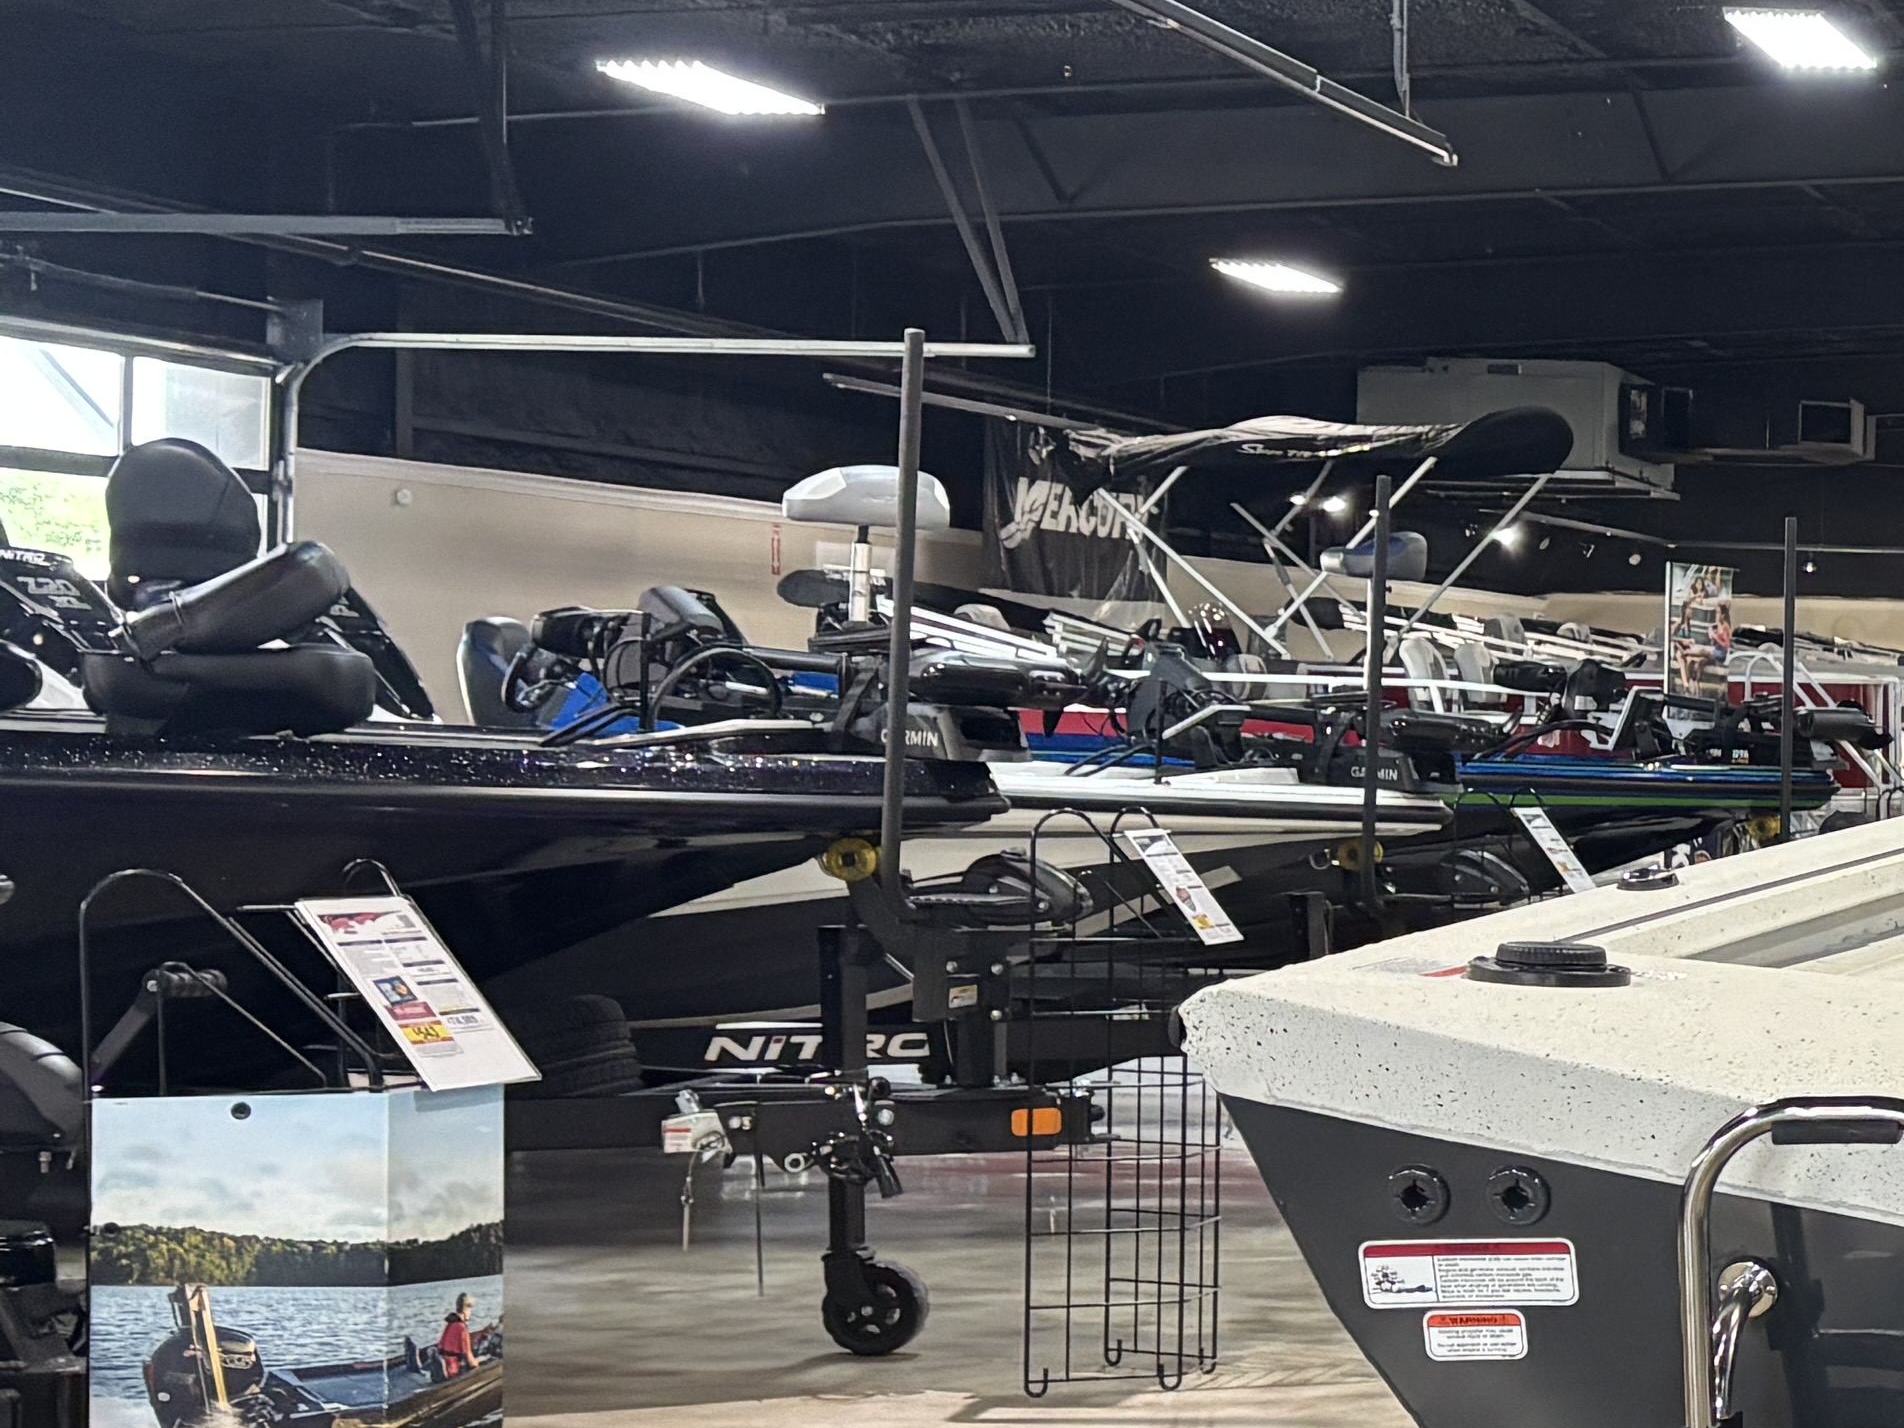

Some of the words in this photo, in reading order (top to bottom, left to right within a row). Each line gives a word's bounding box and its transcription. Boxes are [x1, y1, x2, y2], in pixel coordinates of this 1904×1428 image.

[1000, 475, 1150, 548] MERCUR
[881, 728, 938, 746] GRMIN
[1350, 766, 1398, 781] GAMIN
